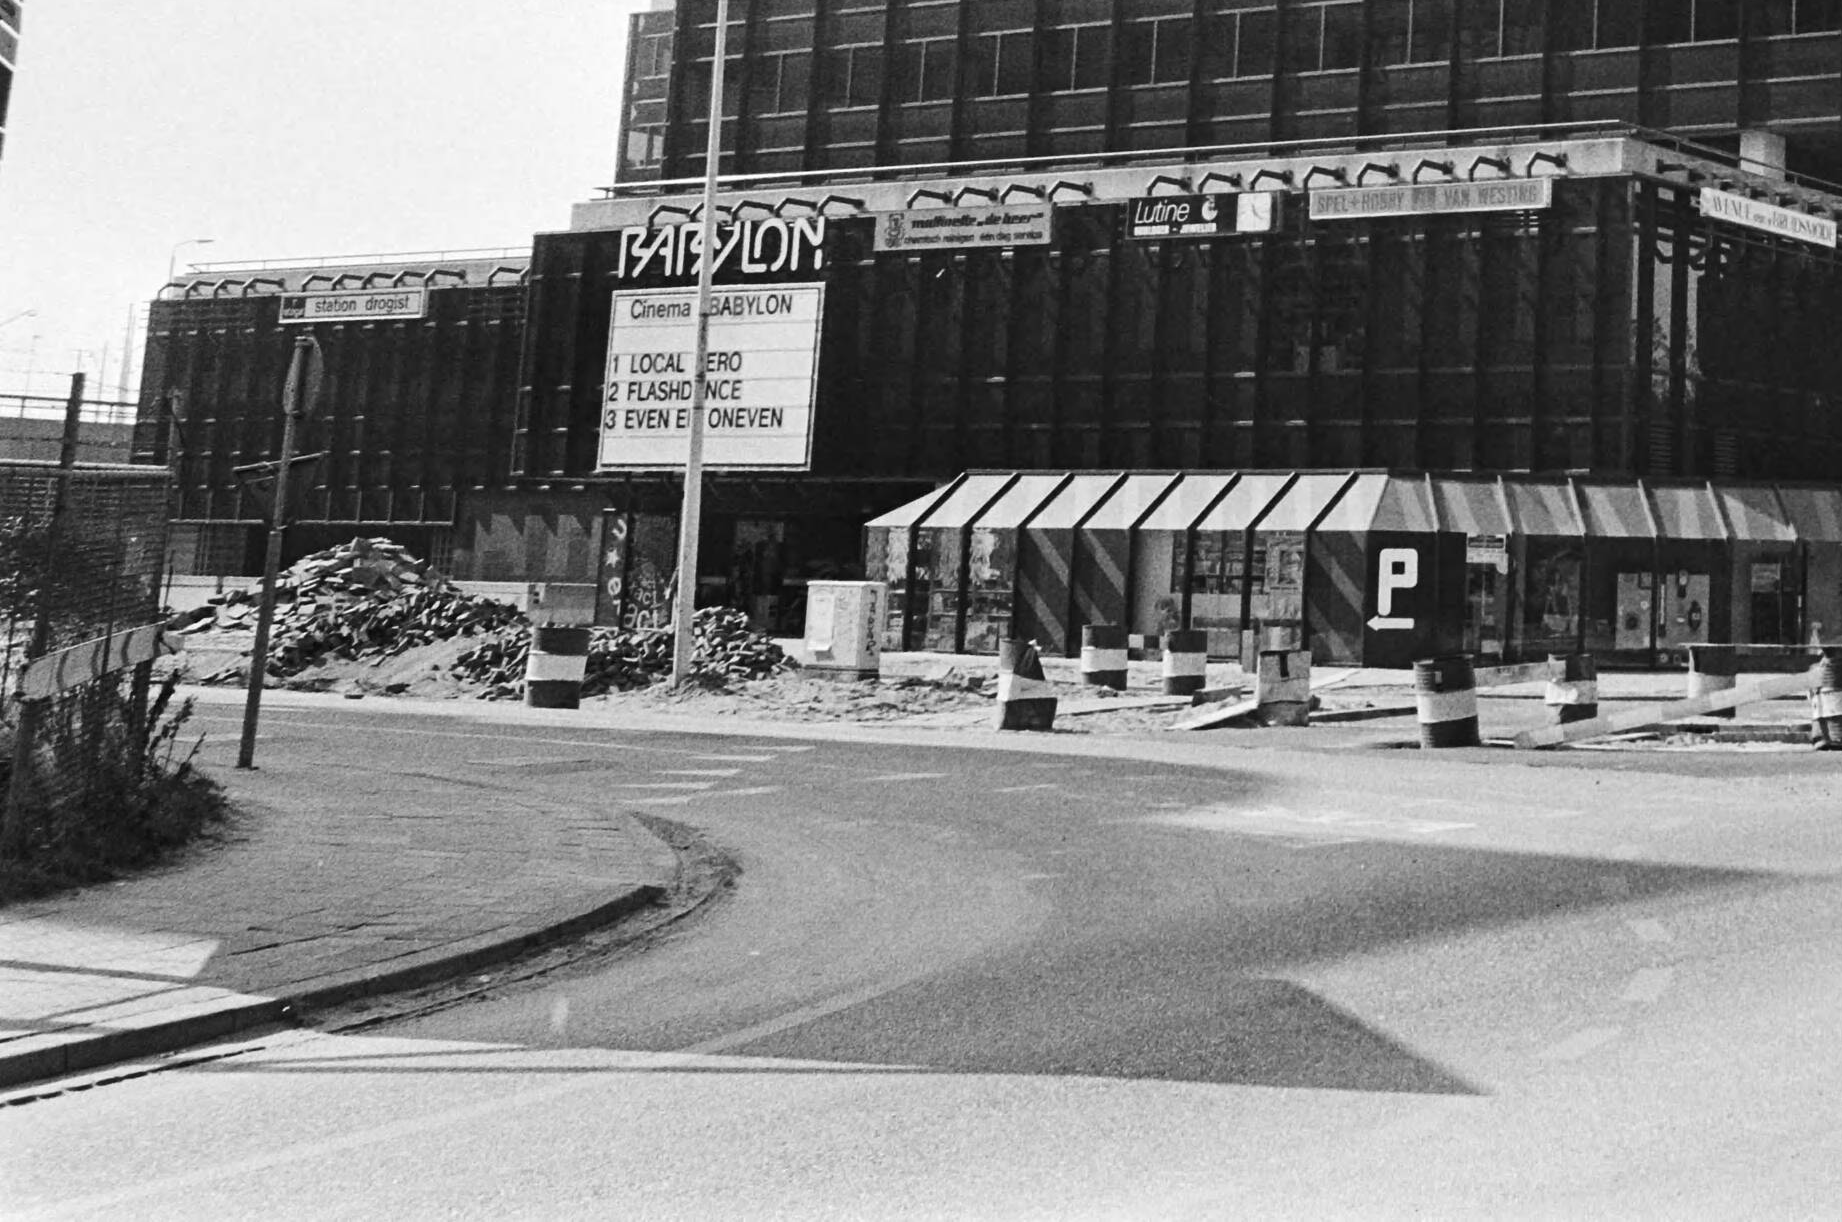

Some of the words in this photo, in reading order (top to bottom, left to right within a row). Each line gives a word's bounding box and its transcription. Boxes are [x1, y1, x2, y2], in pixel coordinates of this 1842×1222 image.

[1134, 198, 1191, 225] Lutine
[618, 215, 825, 279] BABYLON
[314, 297, 357, 313] station
[364, 294, 410, 314] drogist
[630, 298, 692, 320] Cinema
[708, 293, 793, 317] BABYLON
[612, 356, 619, 374] 1
[629, 353, 686, 374] LOCAL
[706, 351, 743, 373] ERO
[606, 382, 619, 402] 2
[627, 380, 743, 402] FLASHDNCE
[604, 409, 616, 429] 3
[624, 409, 670, 430] EVEN
[675, 408, 691, 429] E
[708, 407, 784, 429] ONEVEN
[1377, 547, 1419, 617] P
